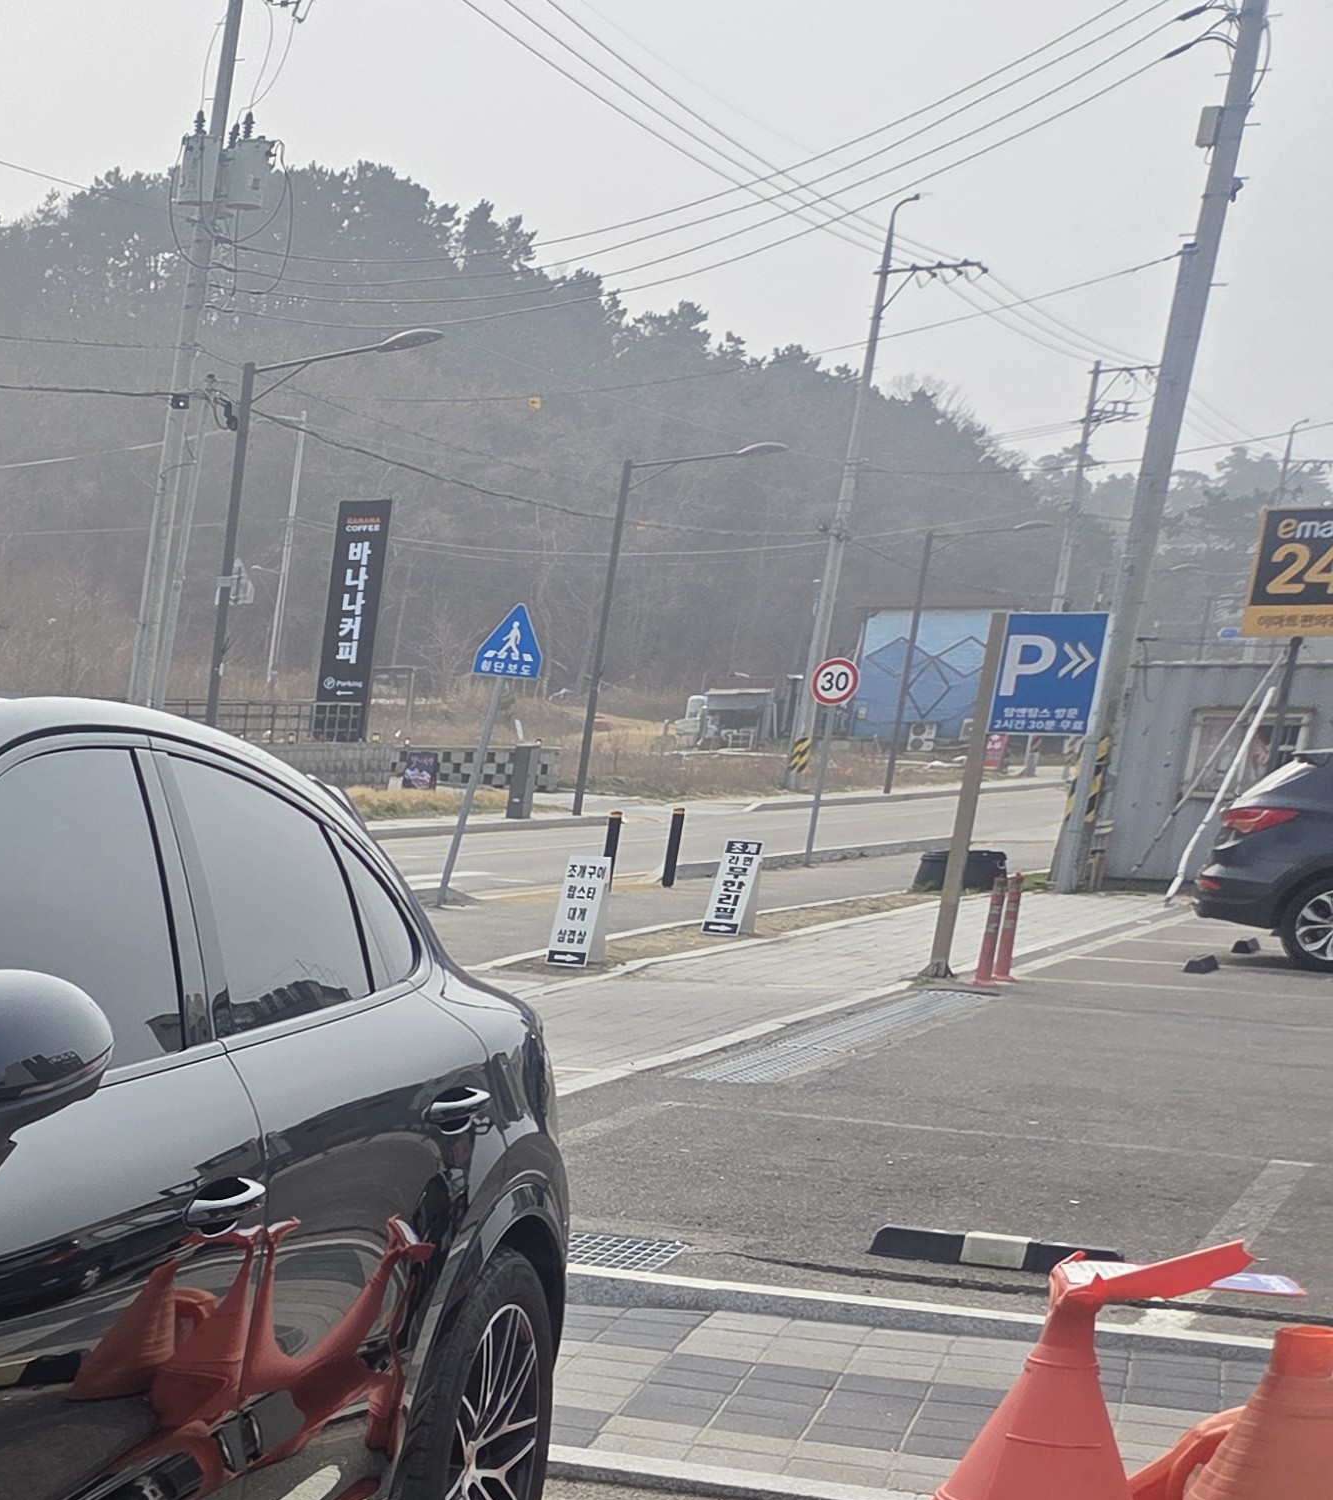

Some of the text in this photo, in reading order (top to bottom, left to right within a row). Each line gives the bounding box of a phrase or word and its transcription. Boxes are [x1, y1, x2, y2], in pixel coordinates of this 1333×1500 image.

[345, 524, 380, 532] COFFEE
[1265, 543, 1333, 595] 24
[336, 541, 372, 664] 바나나커피
[998, 634, 1057, 696] P
[820, 671, 849, 692] 30
[994, 719, 1026, 730] 2시간
[728, 855, 754, 867] 라면
[567, 864, 607, 880] 조개구이
[557, 928, 587, 945] 삼겹살
